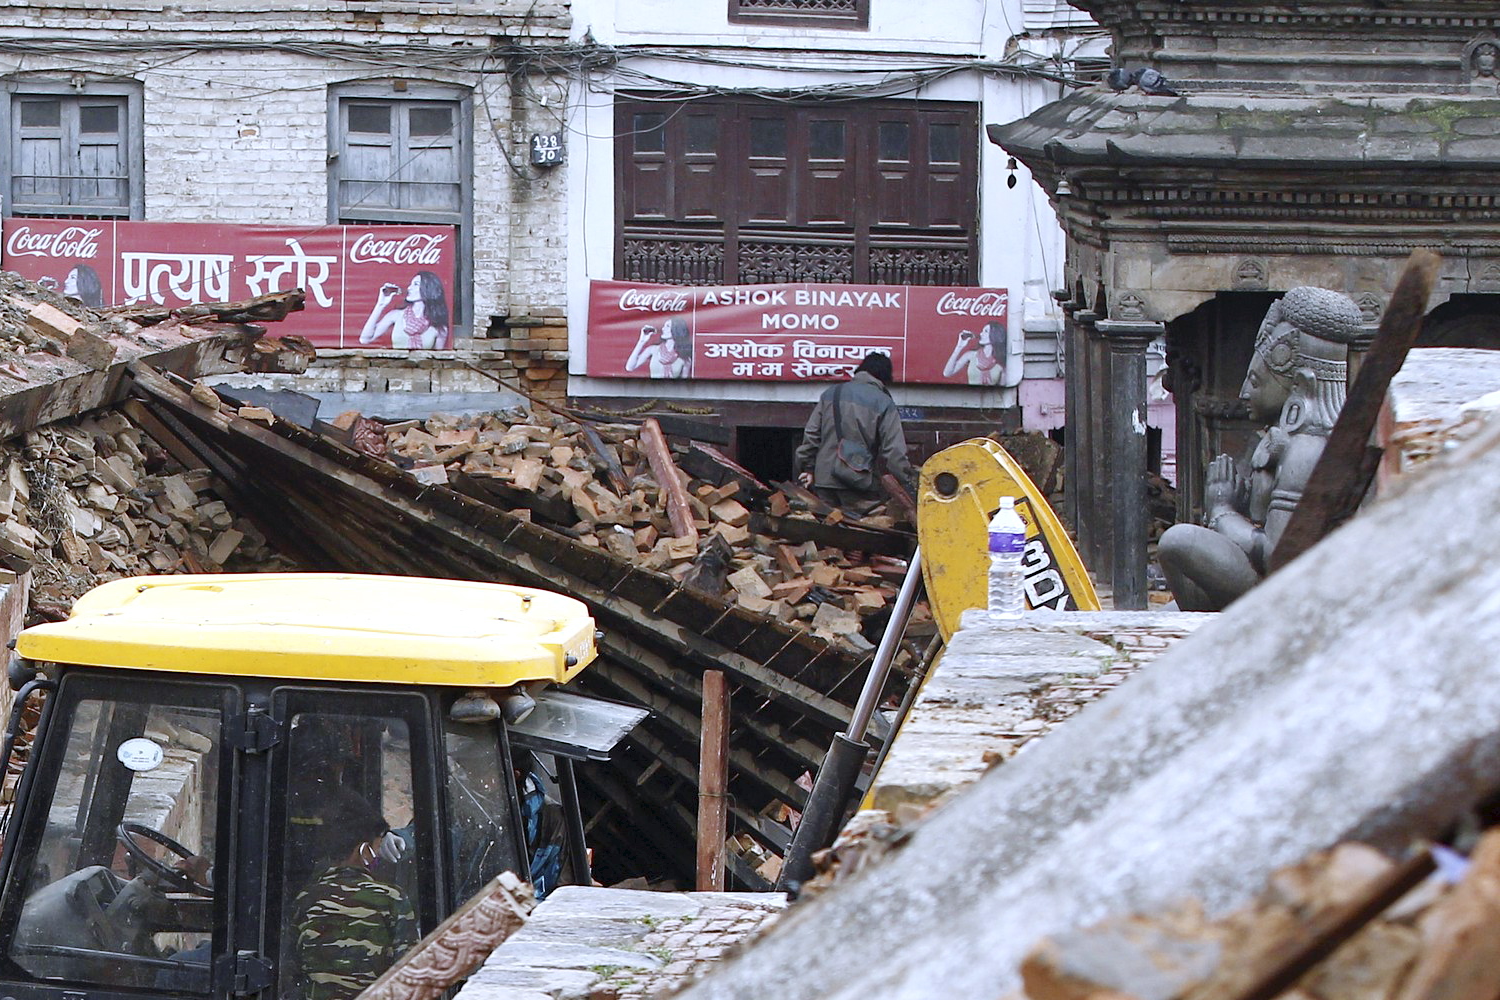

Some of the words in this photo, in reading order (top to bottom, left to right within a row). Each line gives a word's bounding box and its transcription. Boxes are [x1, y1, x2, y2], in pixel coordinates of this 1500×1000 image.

[534, 135, 558, 148] 138
[538, 150, 556, 163] 30
[7, 226, 103, 258] Coca-Cola
[349, 233, 448, 264] Coca-Cola
[245, 237, 338, 308] स्टोर
[618, 288, 690, 312] Coca-Cola
[702, 290, 787, 306] ASHOK
[795, 289, 901, 308] BINAYAK
[936, 291, 1008, 317] Coca-Cola
[762, 313, 840, 331] MOMO
[704, 339, 785, 359] अशोक
